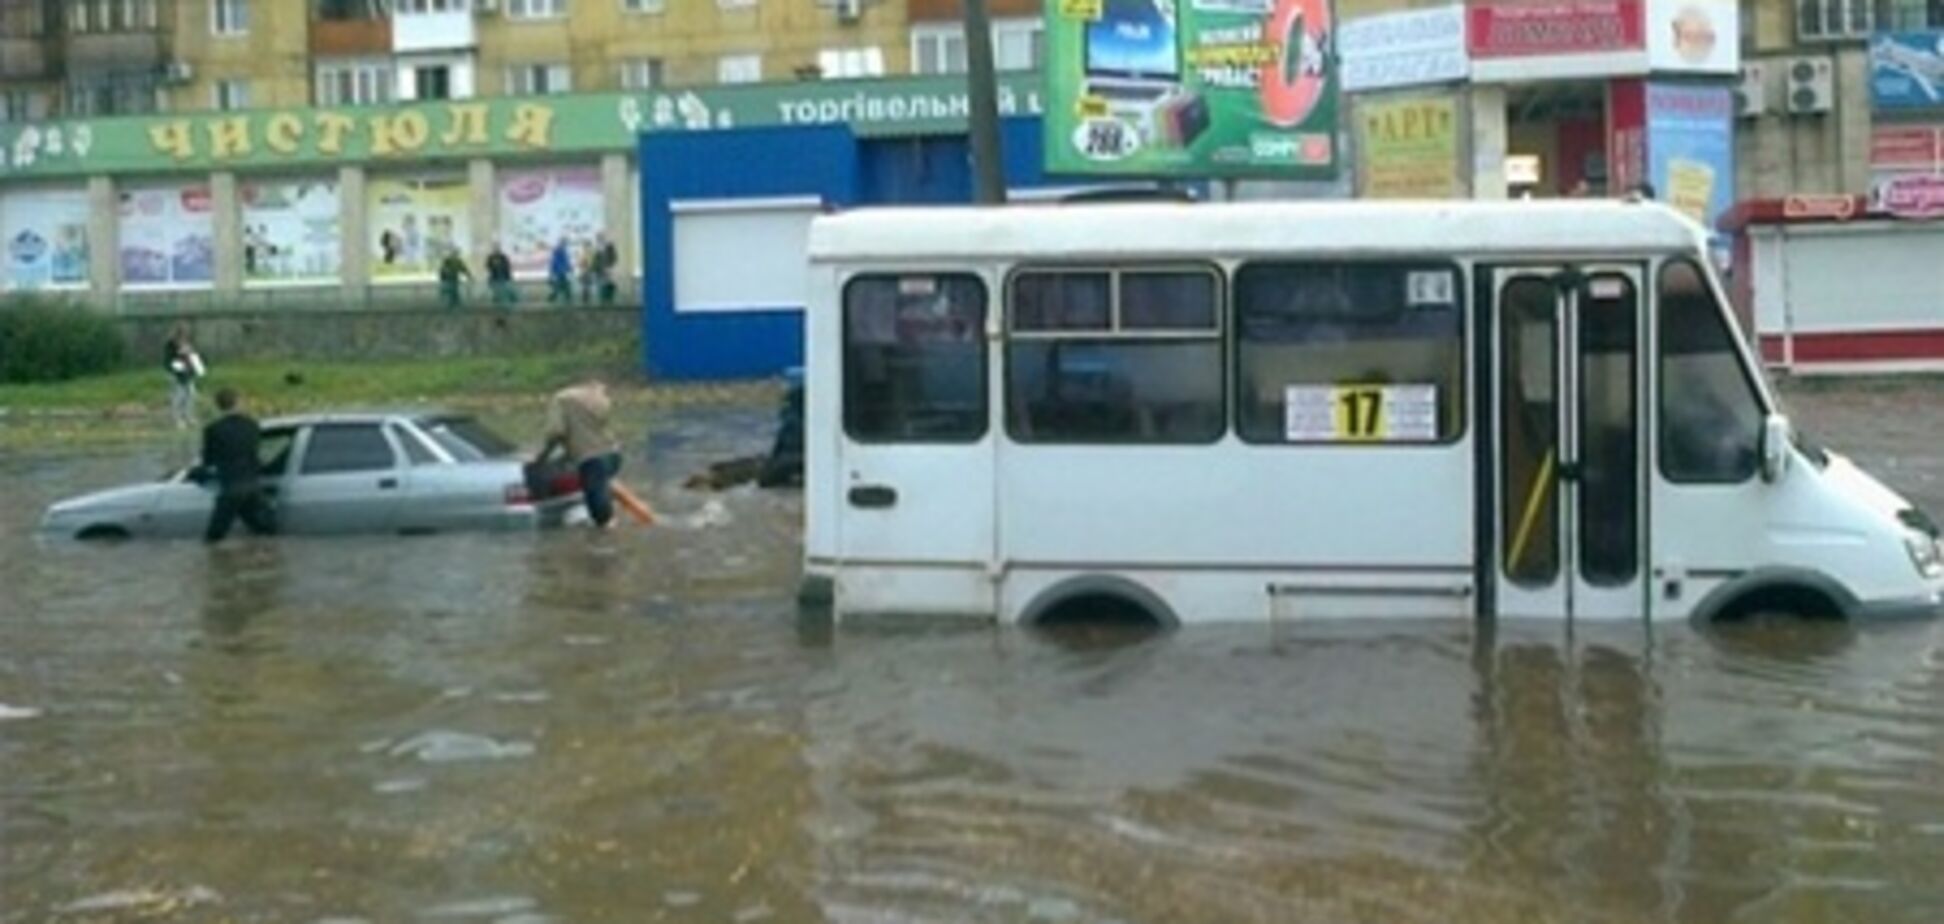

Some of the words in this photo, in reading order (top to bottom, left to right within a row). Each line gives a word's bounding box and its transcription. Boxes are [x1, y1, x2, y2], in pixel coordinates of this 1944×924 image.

[148, 103, 554, 157] ЧИСТЮЛЯ
[779, 91, 1017, 124] торгівельнй
[1340, 391, 1382, 436] 17
